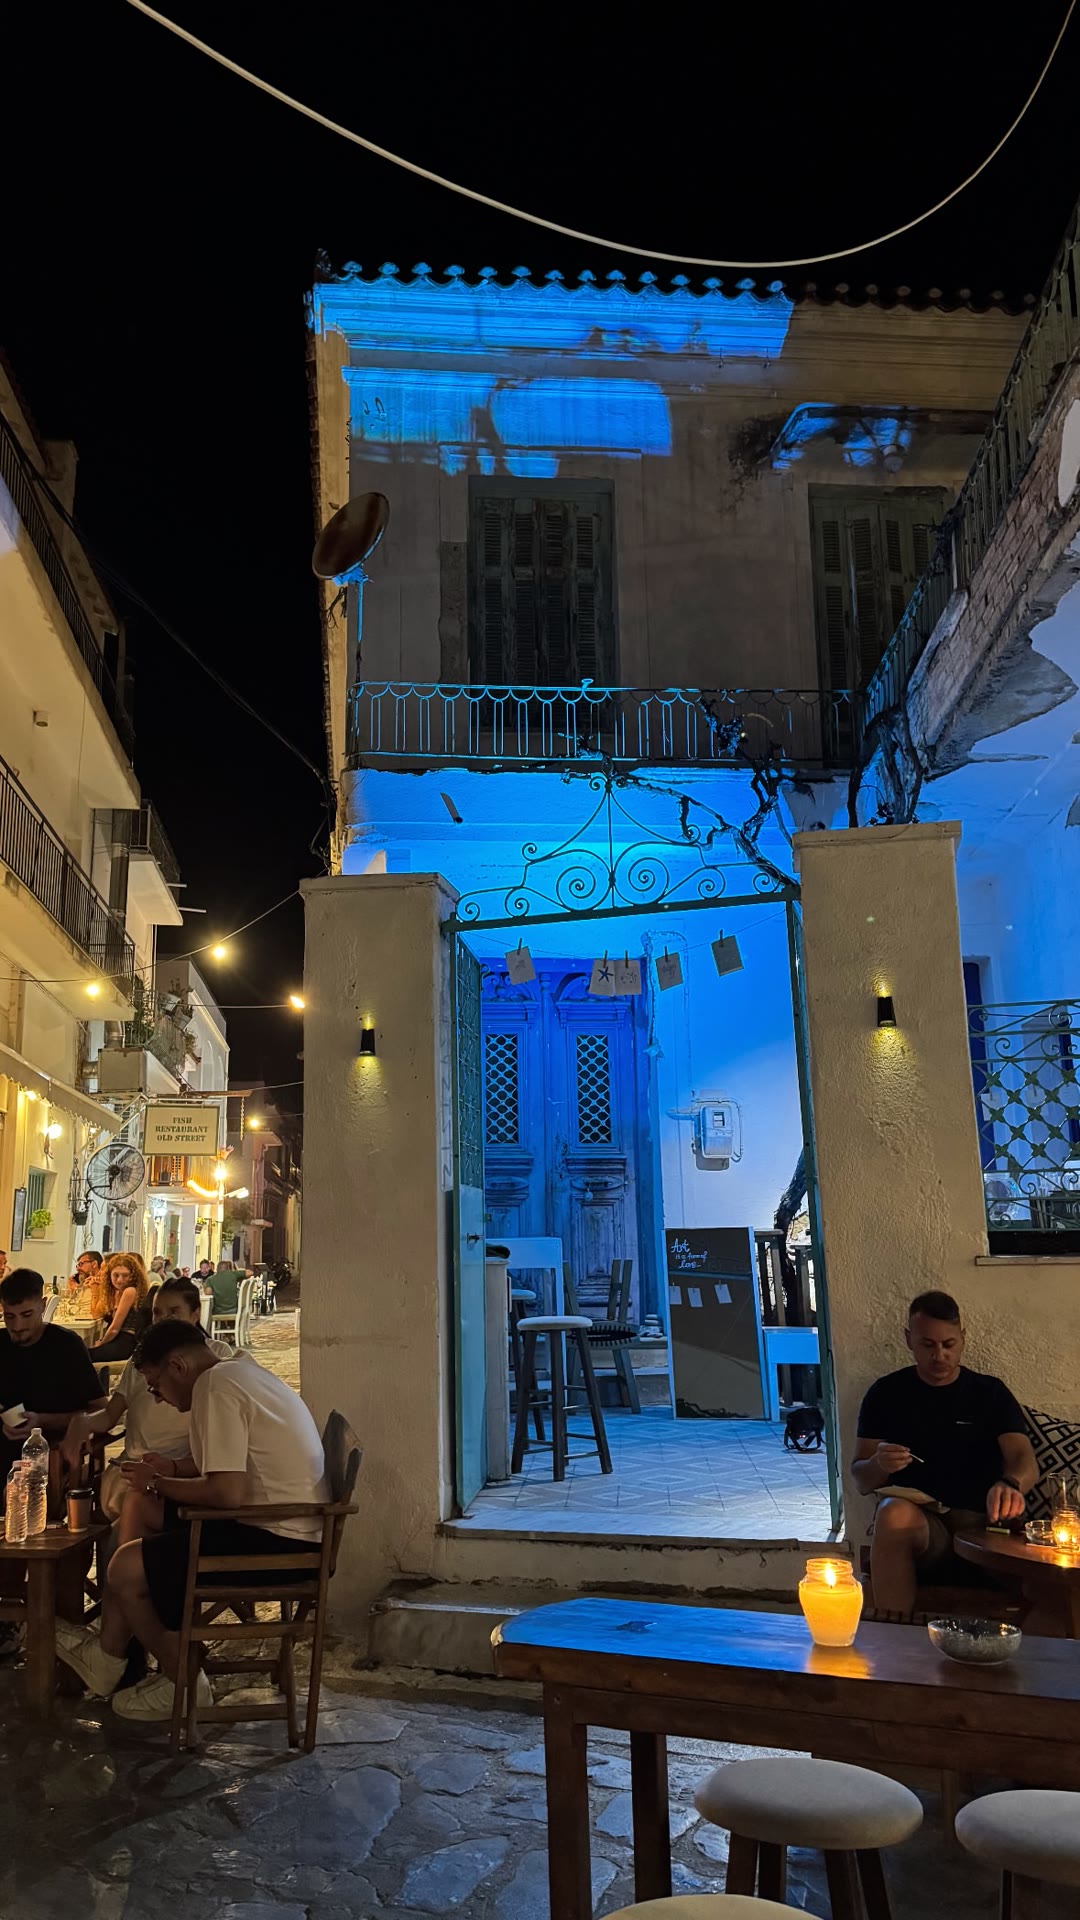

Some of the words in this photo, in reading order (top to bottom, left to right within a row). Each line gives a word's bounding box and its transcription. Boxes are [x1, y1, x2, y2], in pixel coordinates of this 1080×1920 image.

[155, 1125, 208, 1133] RESTAURANT
[157, 1134, 173, 1142] OLD
[670, 1238, 690, 1253] Art
